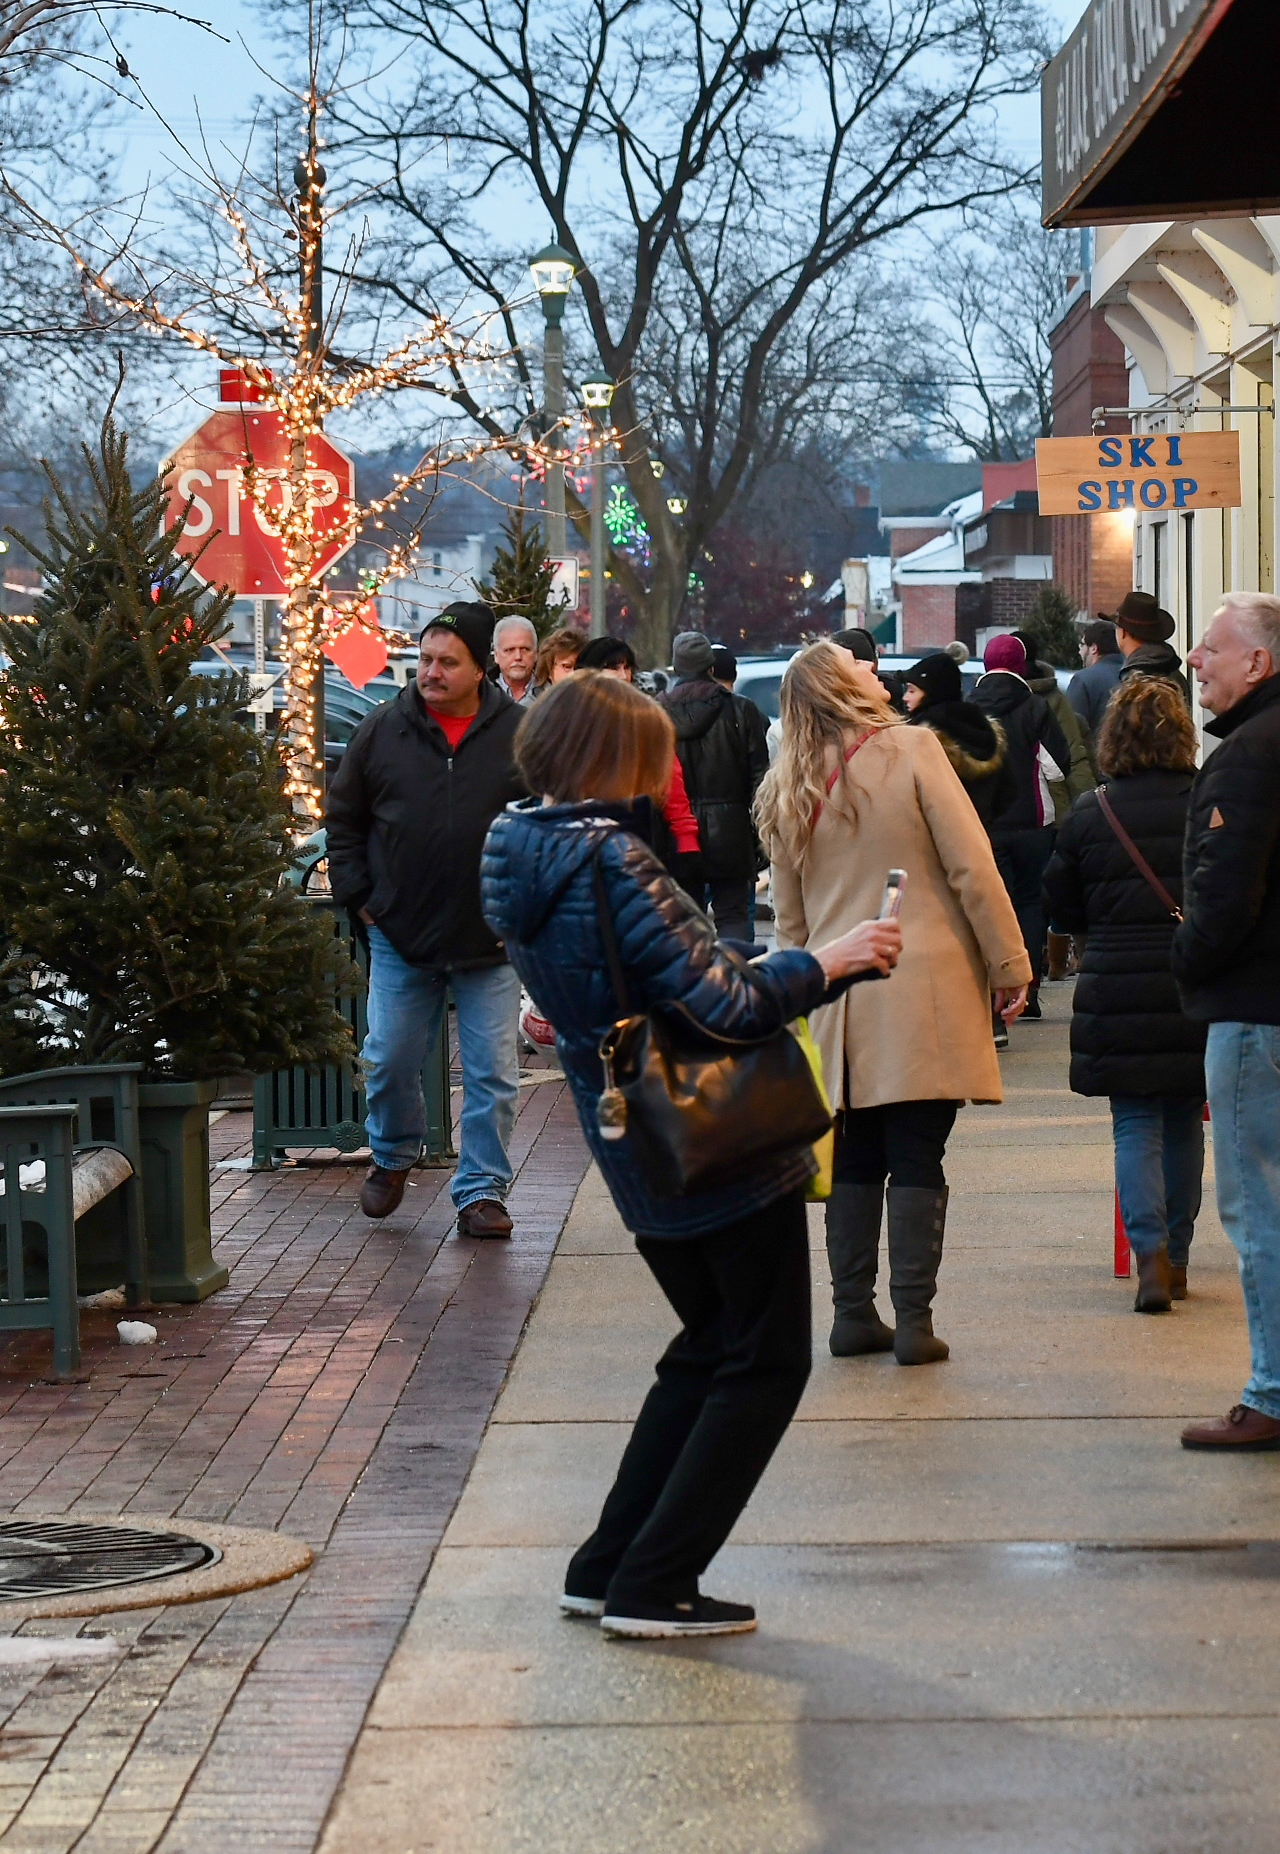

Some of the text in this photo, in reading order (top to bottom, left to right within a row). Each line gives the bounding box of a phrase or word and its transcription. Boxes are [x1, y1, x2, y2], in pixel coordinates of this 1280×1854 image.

[1098, 436, 1183, 467] SKI
[177, 468, 340, 537] STOP
[1078, 478, 1198, 510] SHOP
